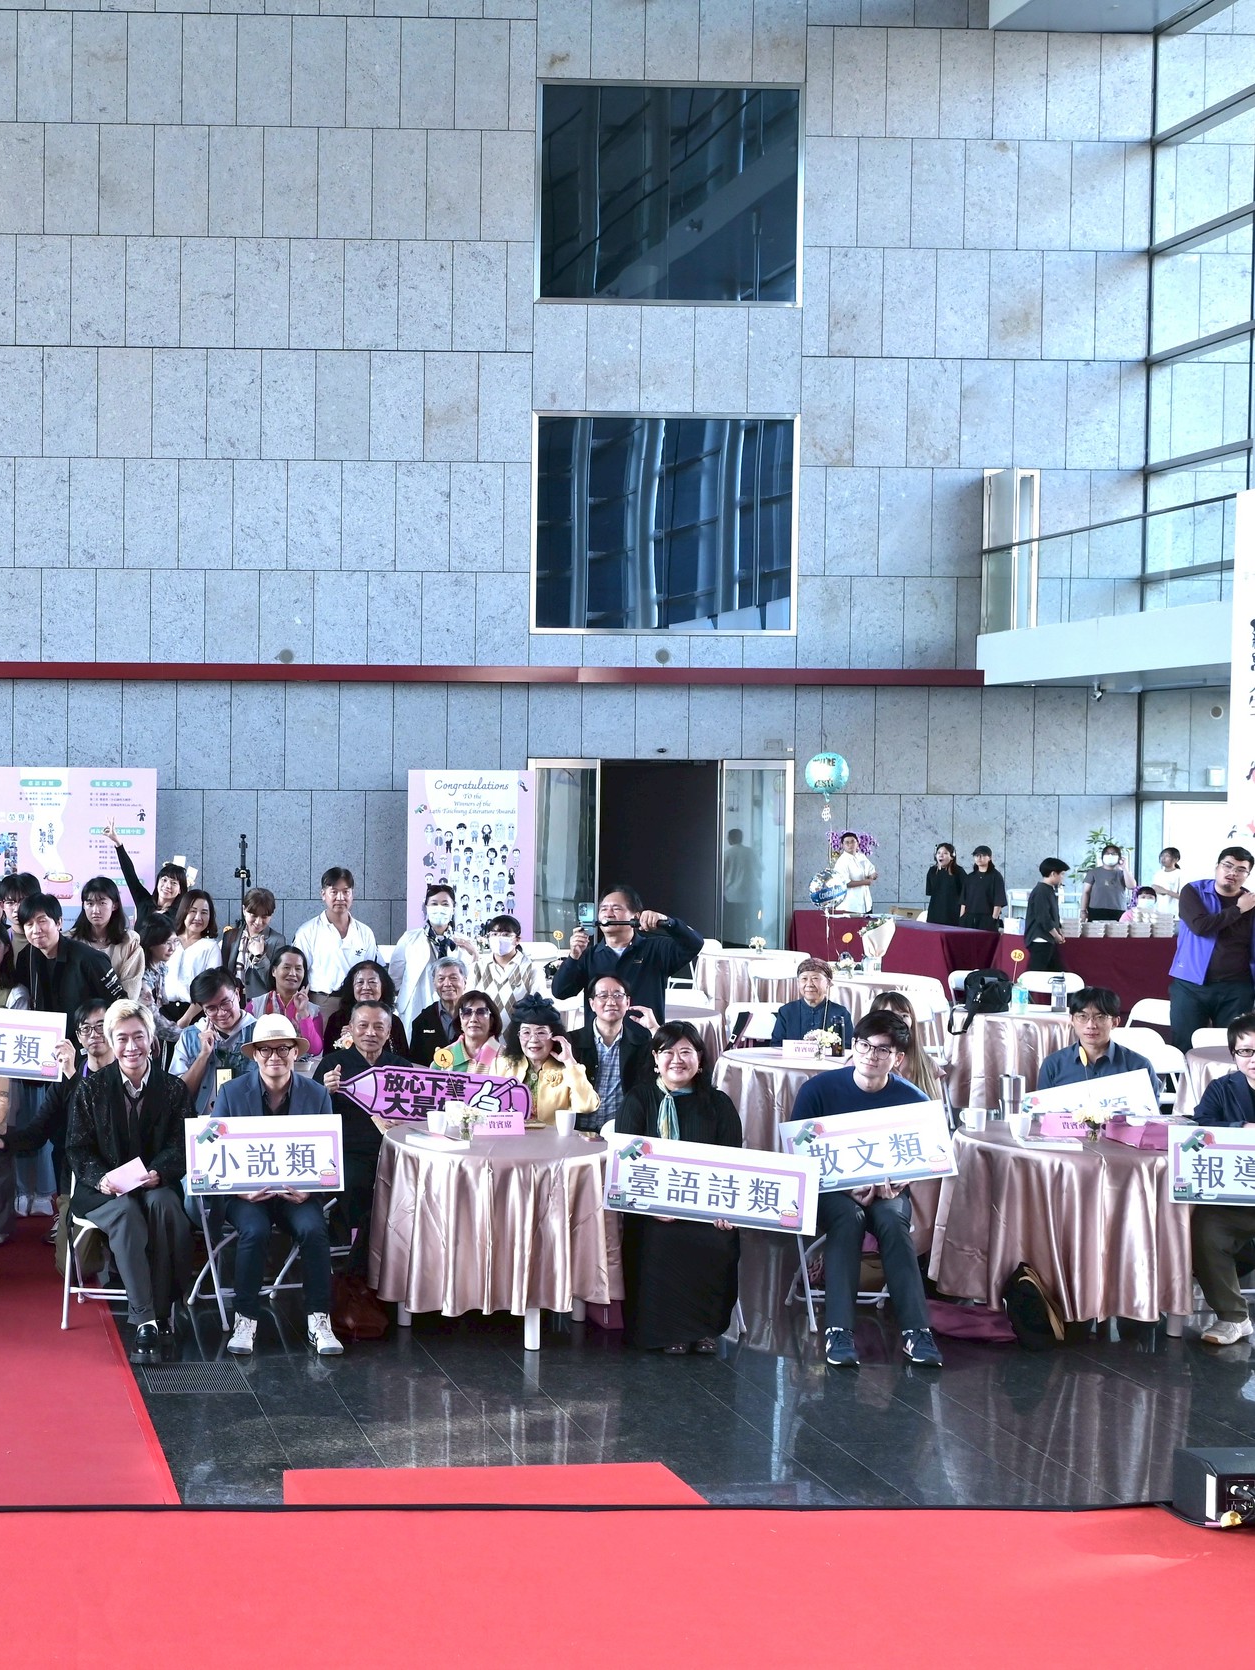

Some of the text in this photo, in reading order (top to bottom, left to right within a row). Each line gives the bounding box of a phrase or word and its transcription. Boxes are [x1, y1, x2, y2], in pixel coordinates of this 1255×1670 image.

[434, 776, 509, 796] Congratulations
[440, 1053, 447, 1063] 4
[383, 1073, 466, 1098] 放心下筆
[806, 1132, 927, 1177] 散文類
[626, 1163, 782, 1216] 臺語詩類
